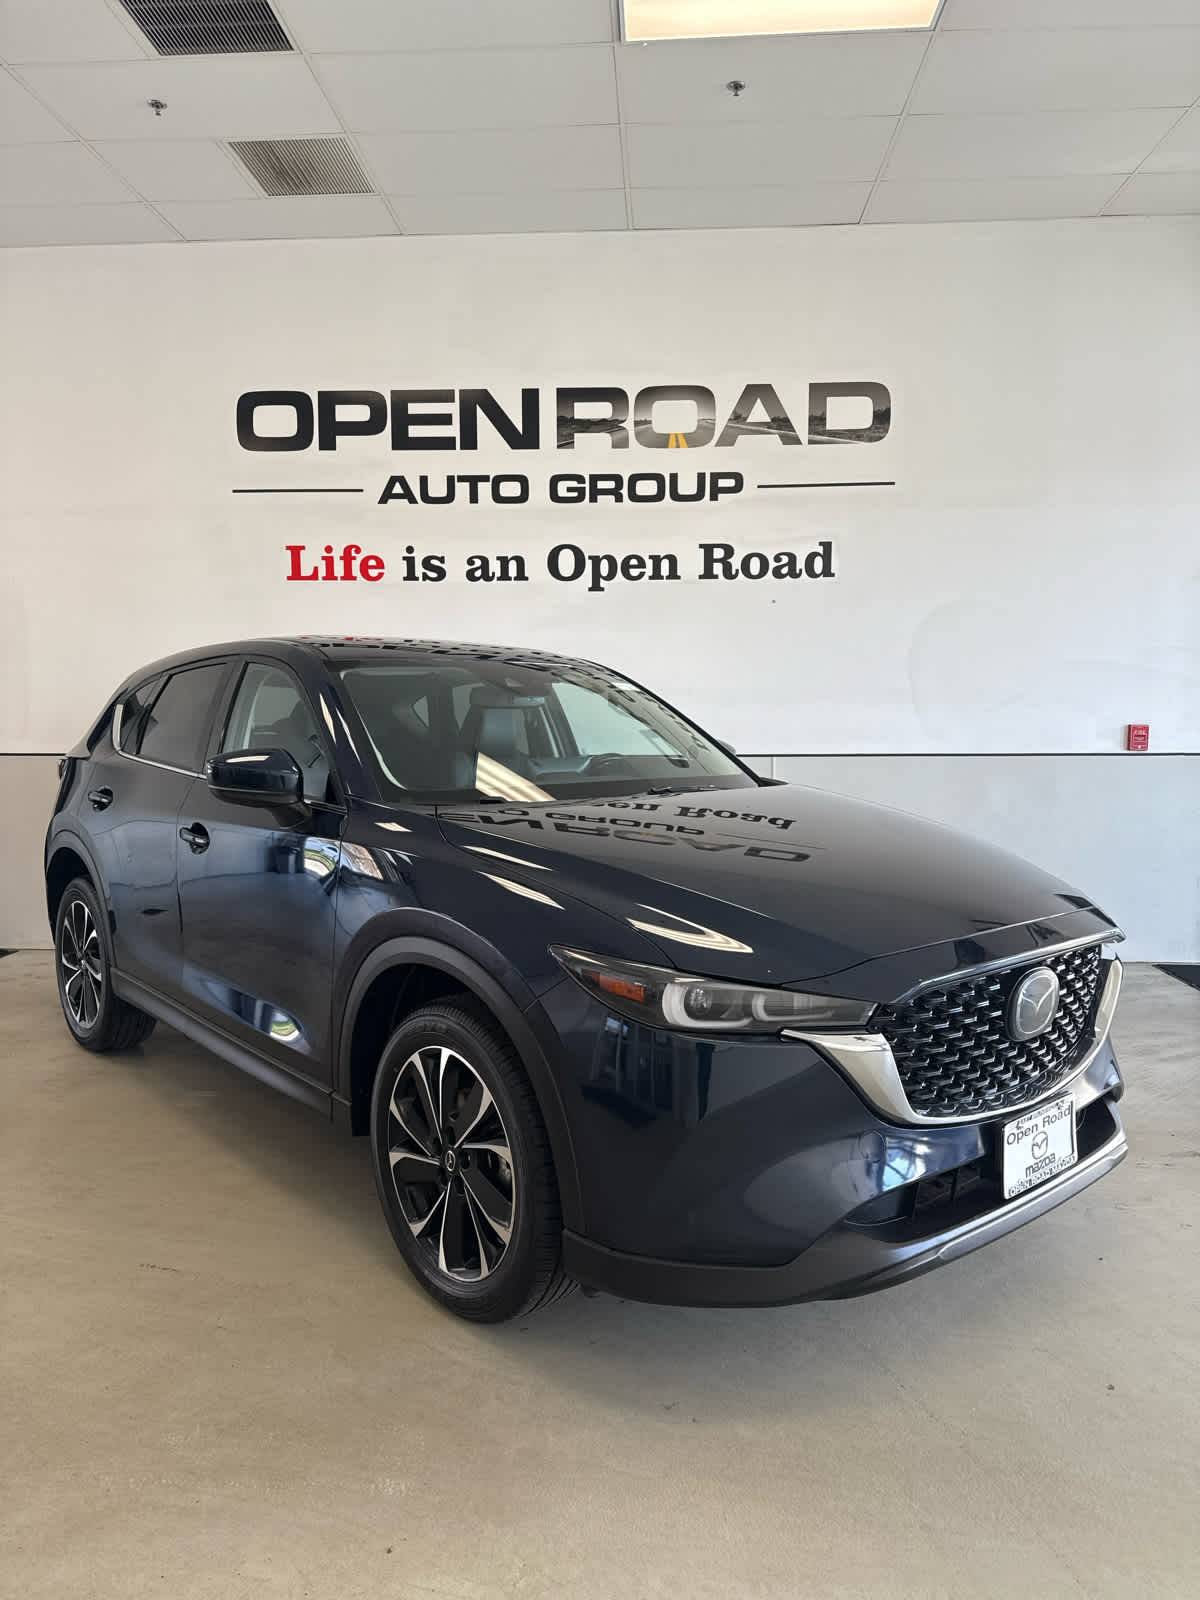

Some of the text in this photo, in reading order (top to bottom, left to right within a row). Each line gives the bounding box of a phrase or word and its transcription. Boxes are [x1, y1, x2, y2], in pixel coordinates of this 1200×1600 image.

[236, 381, 892, 452] OPEN ROAD
[377, 471, 744, 505] AUTO GROUP
[285, 540, 836, 592] Life is an Open Road
[1006, 1123, 1039, 1146] Open
[1042, 1104, 1071, 1129] Road
